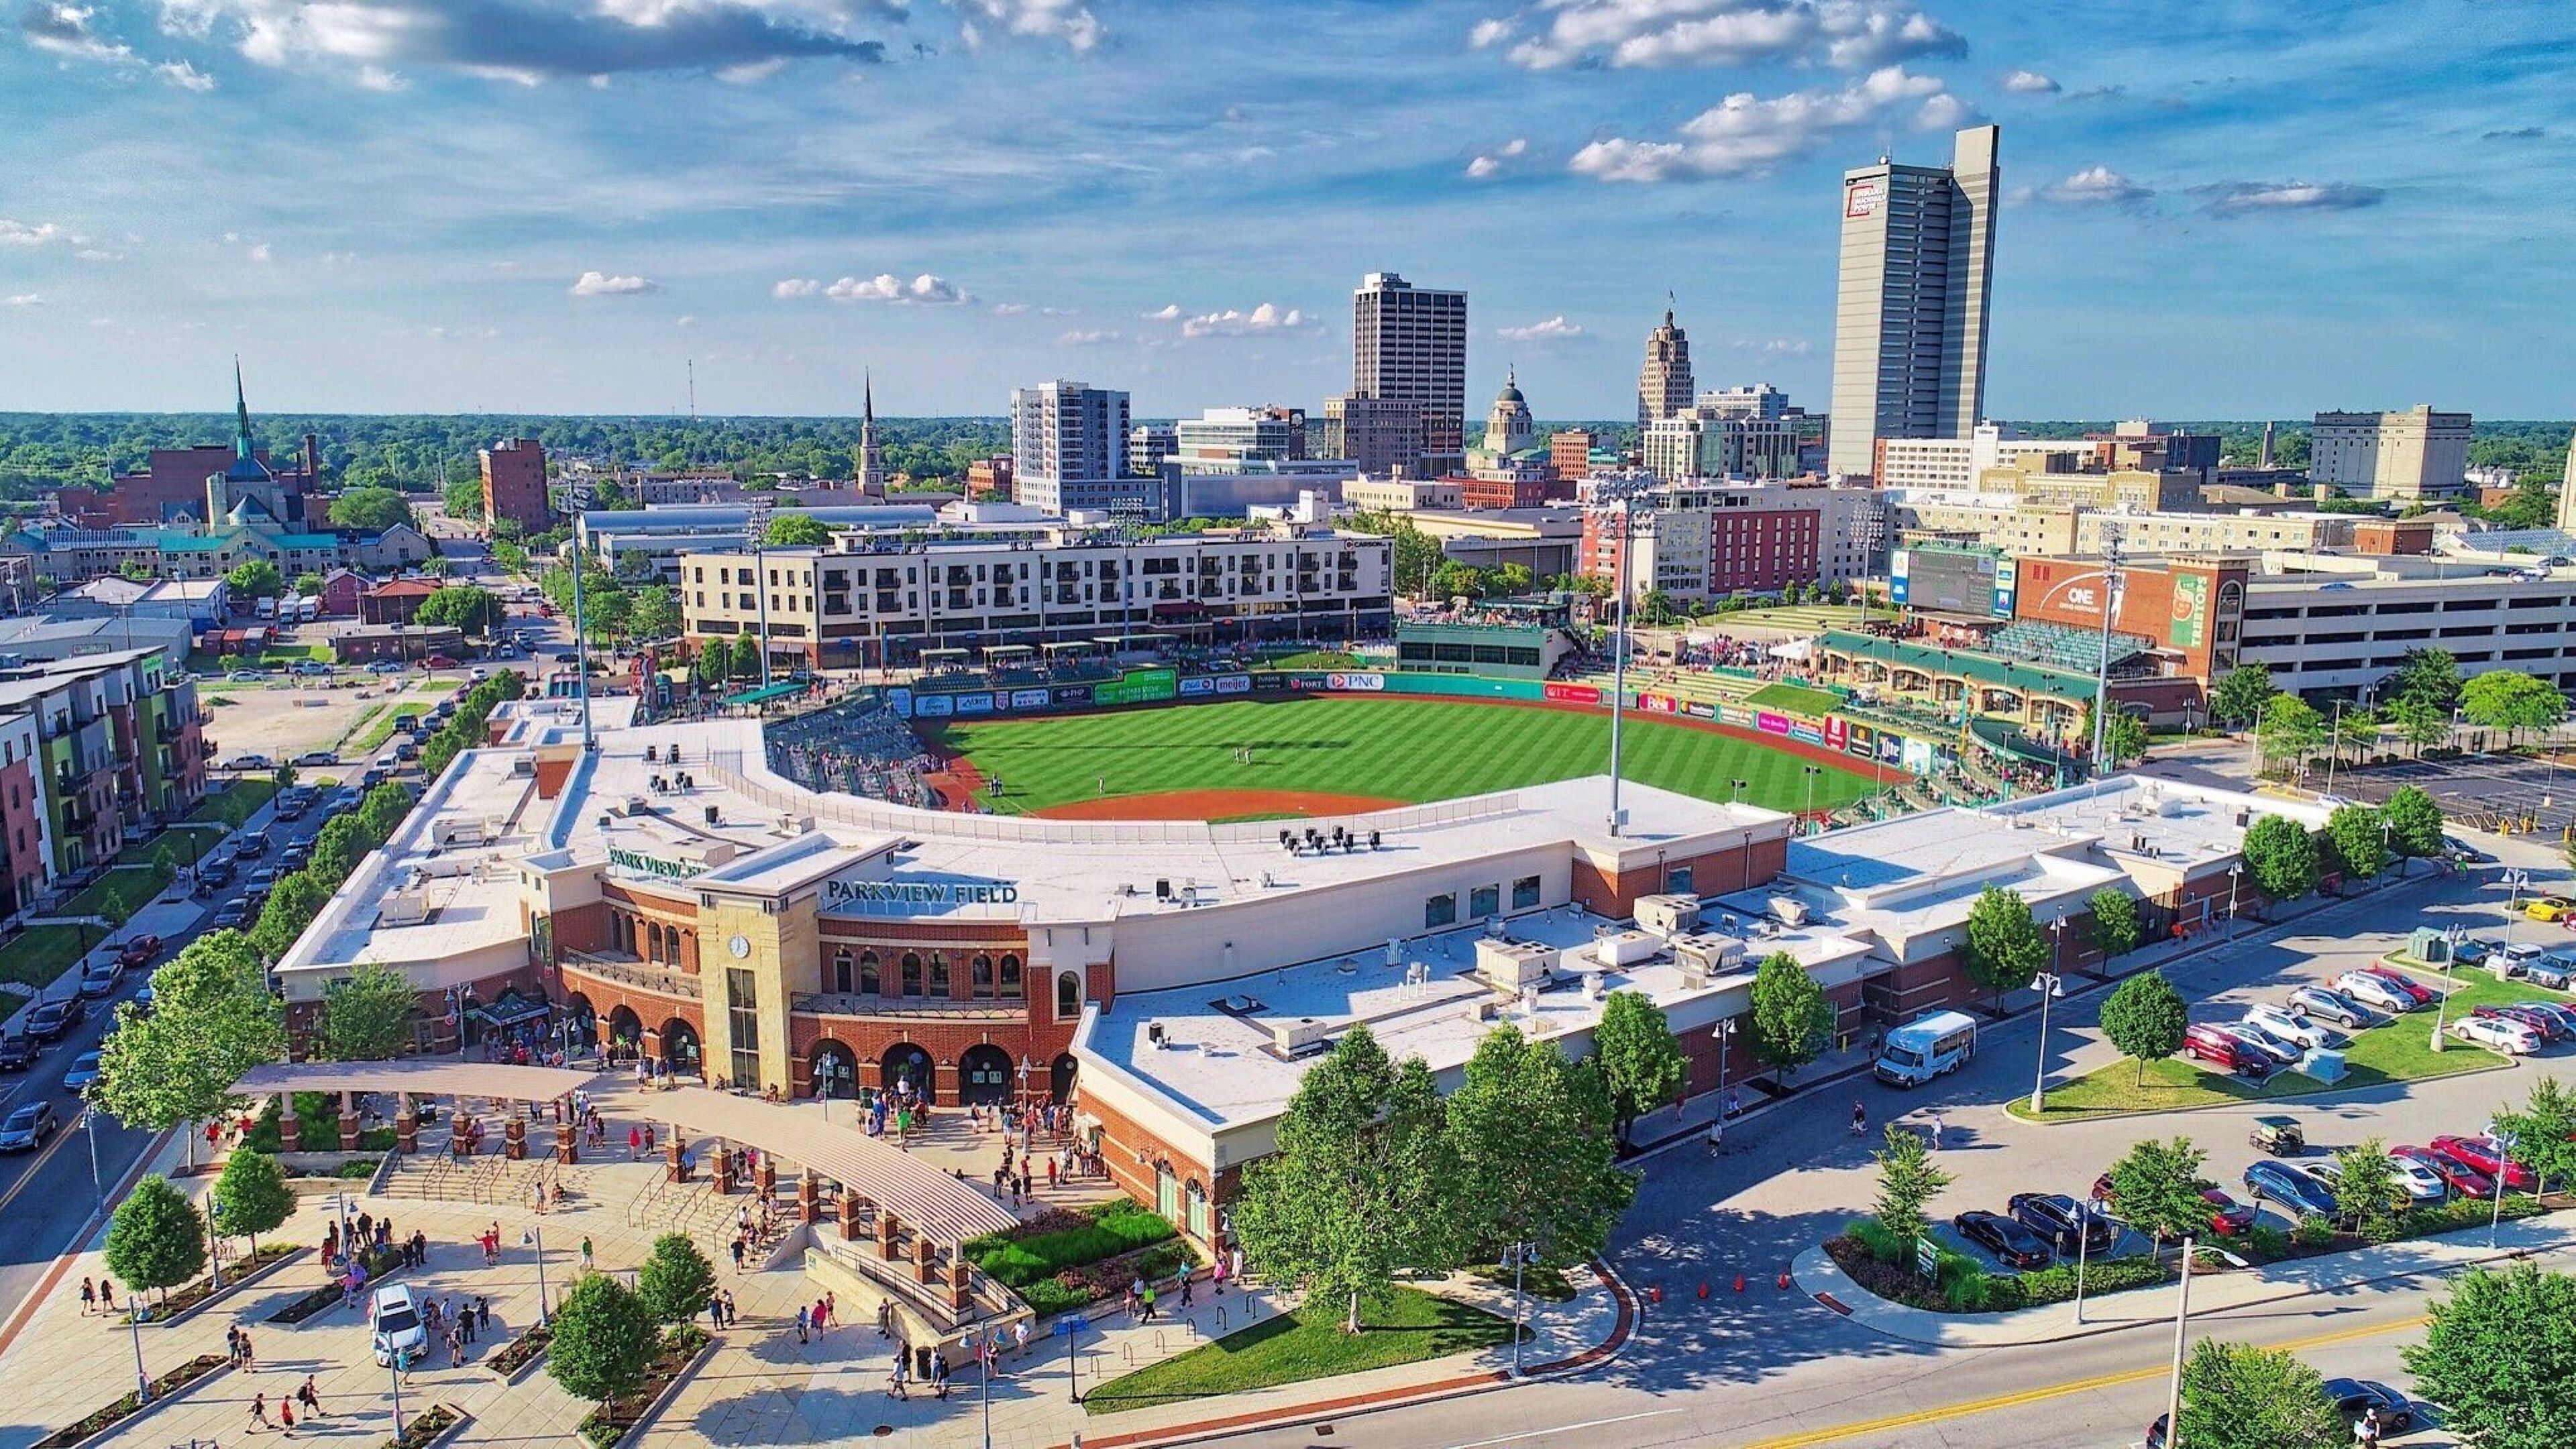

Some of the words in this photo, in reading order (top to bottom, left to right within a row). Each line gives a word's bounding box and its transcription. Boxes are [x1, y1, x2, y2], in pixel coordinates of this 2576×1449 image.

[2068, 587, 2094, 605] ONE
[1220, 678, 1247, 690] meijer
[1348, 675, 1379, 688] PNC
[609, 847, 682, 878] PARKVIEW
[828, 873, 947, 902] PARKVIEW
[955, 884, 1018, 904] FIELD
